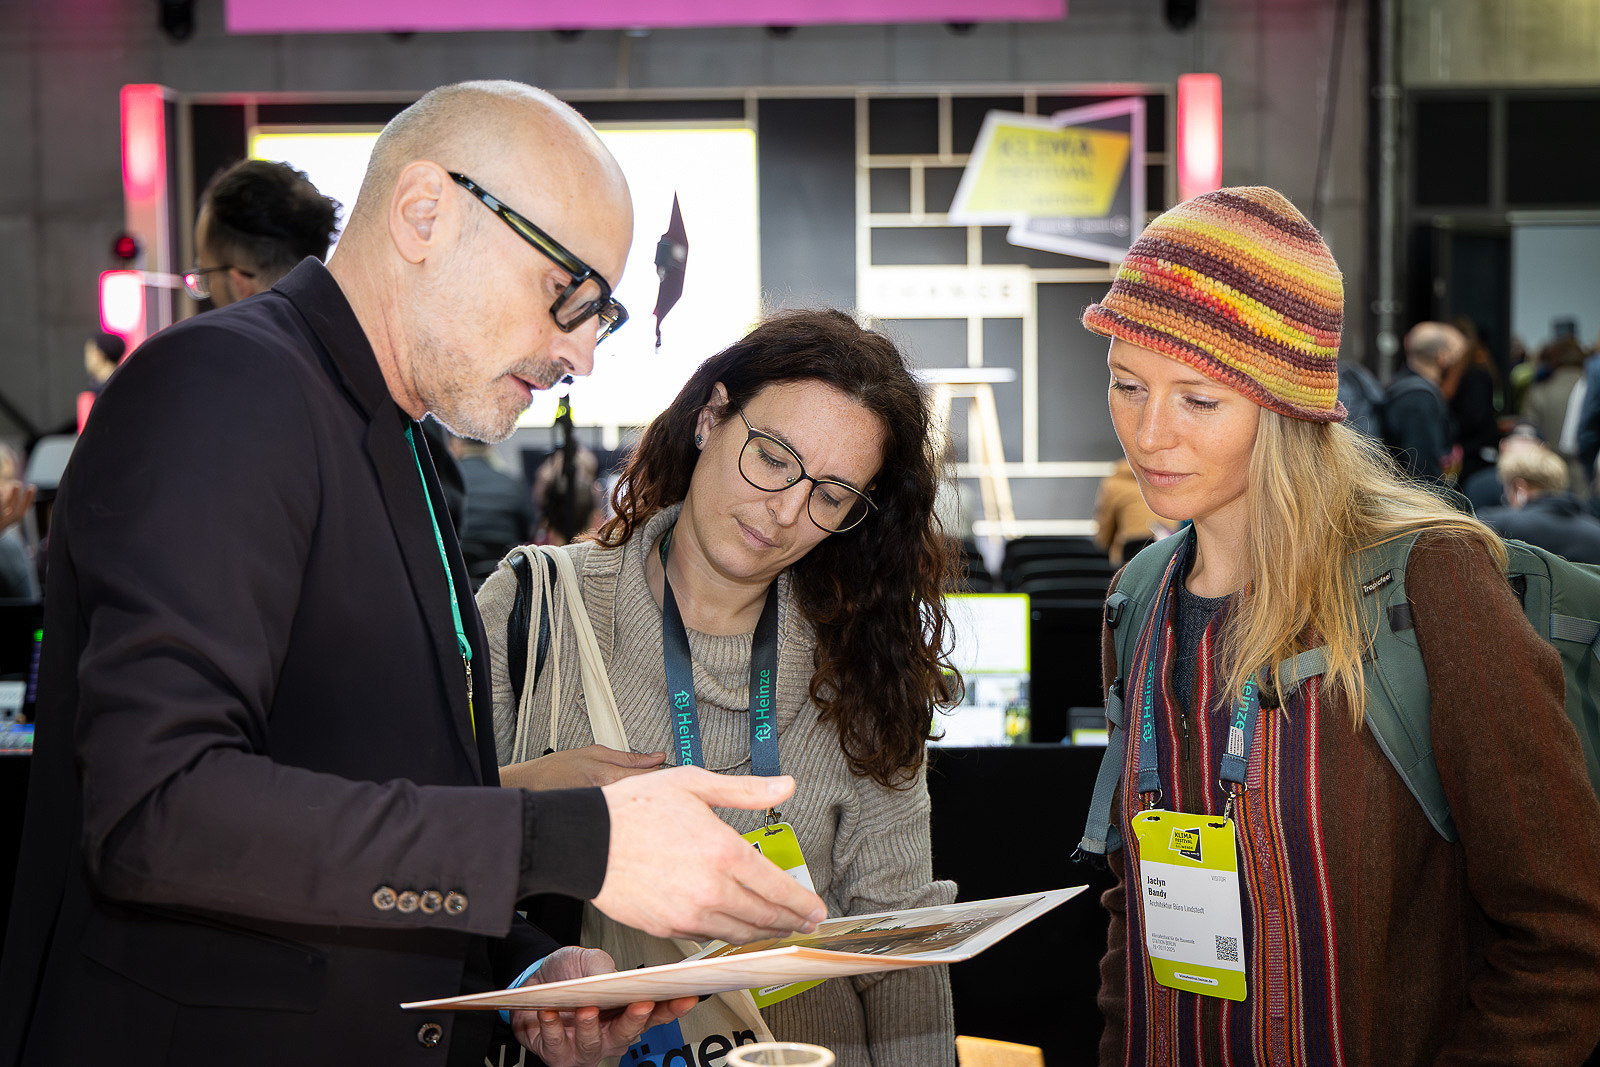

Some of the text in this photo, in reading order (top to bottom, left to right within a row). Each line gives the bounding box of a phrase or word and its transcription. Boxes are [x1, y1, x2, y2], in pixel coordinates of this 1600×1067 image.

[755, 669, 770, 720] Heinze
[1143, 661, 1154, 719] Heinze
[1148, 887, 1167, 899] Bandy
